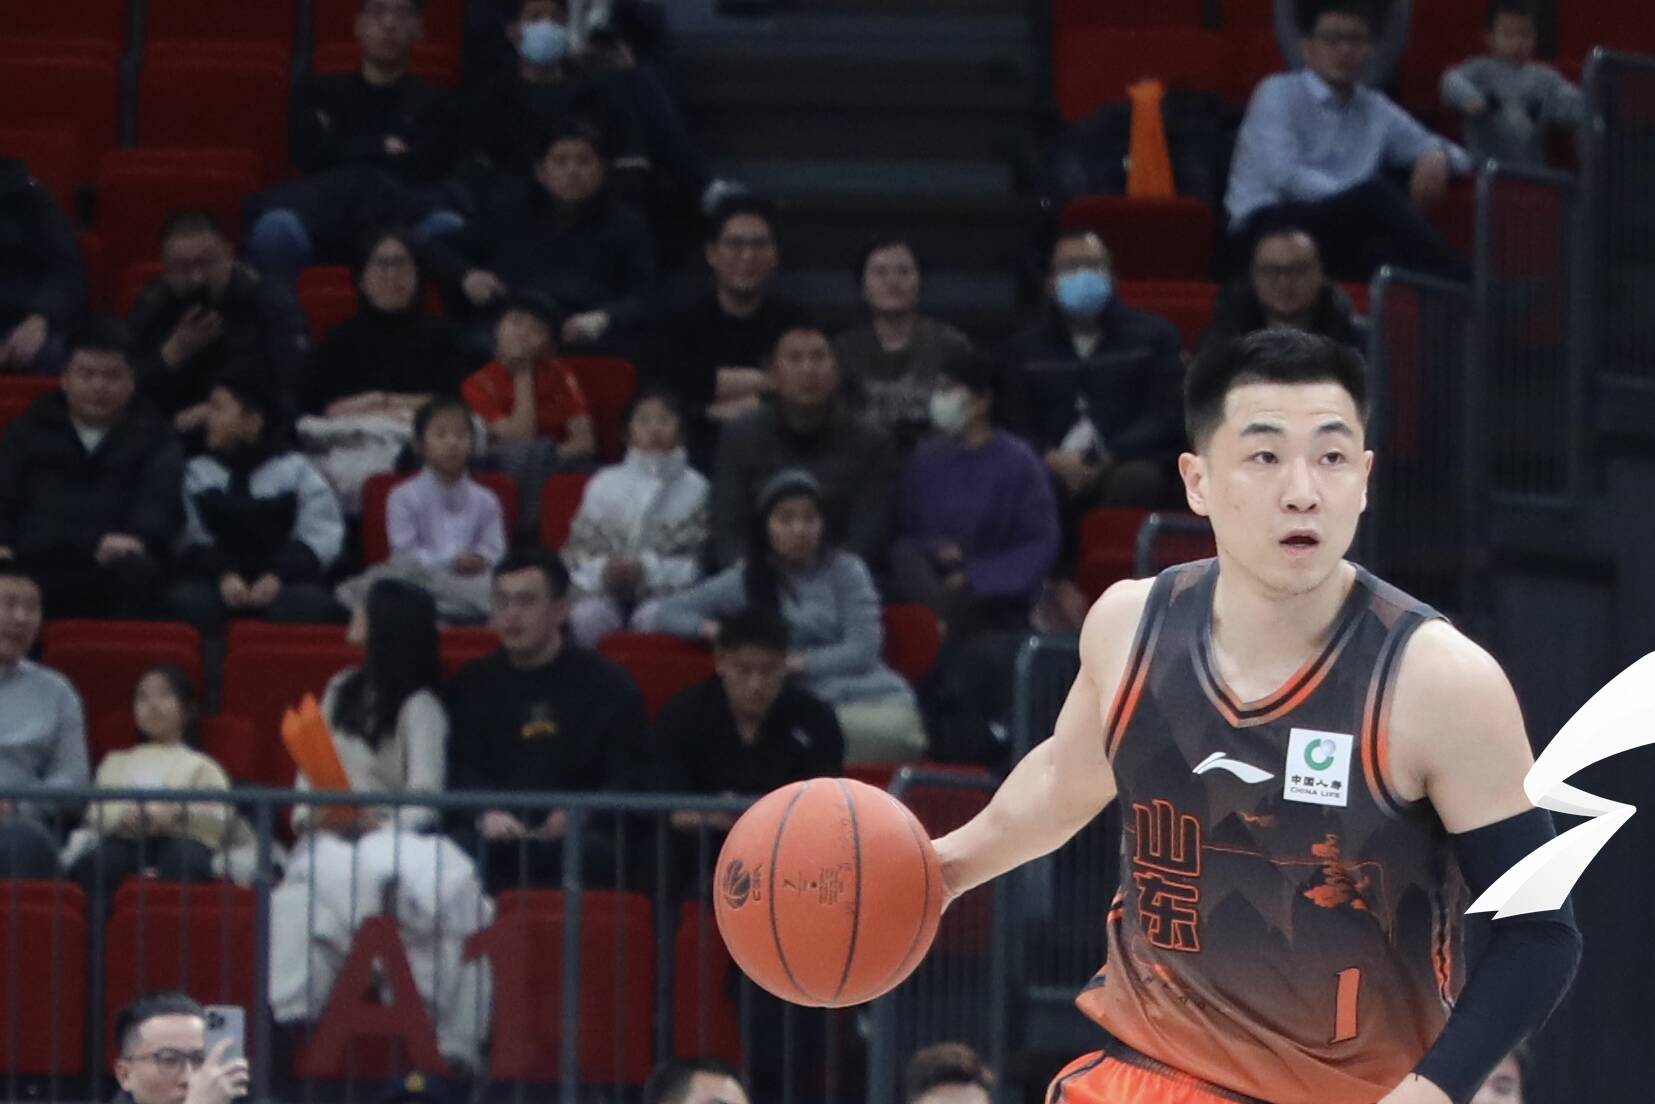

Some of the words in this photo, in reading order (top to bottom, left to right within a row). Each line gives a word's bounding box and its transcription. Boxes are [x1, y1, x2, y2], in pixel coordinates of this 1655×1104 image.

[1290, 786, 1317, 796] CHINA
[1320, 791, 1340, 799] LIFE
[1132, 799, 1201, 952] 山东
[1330, 967, 1361, 1044] 1
